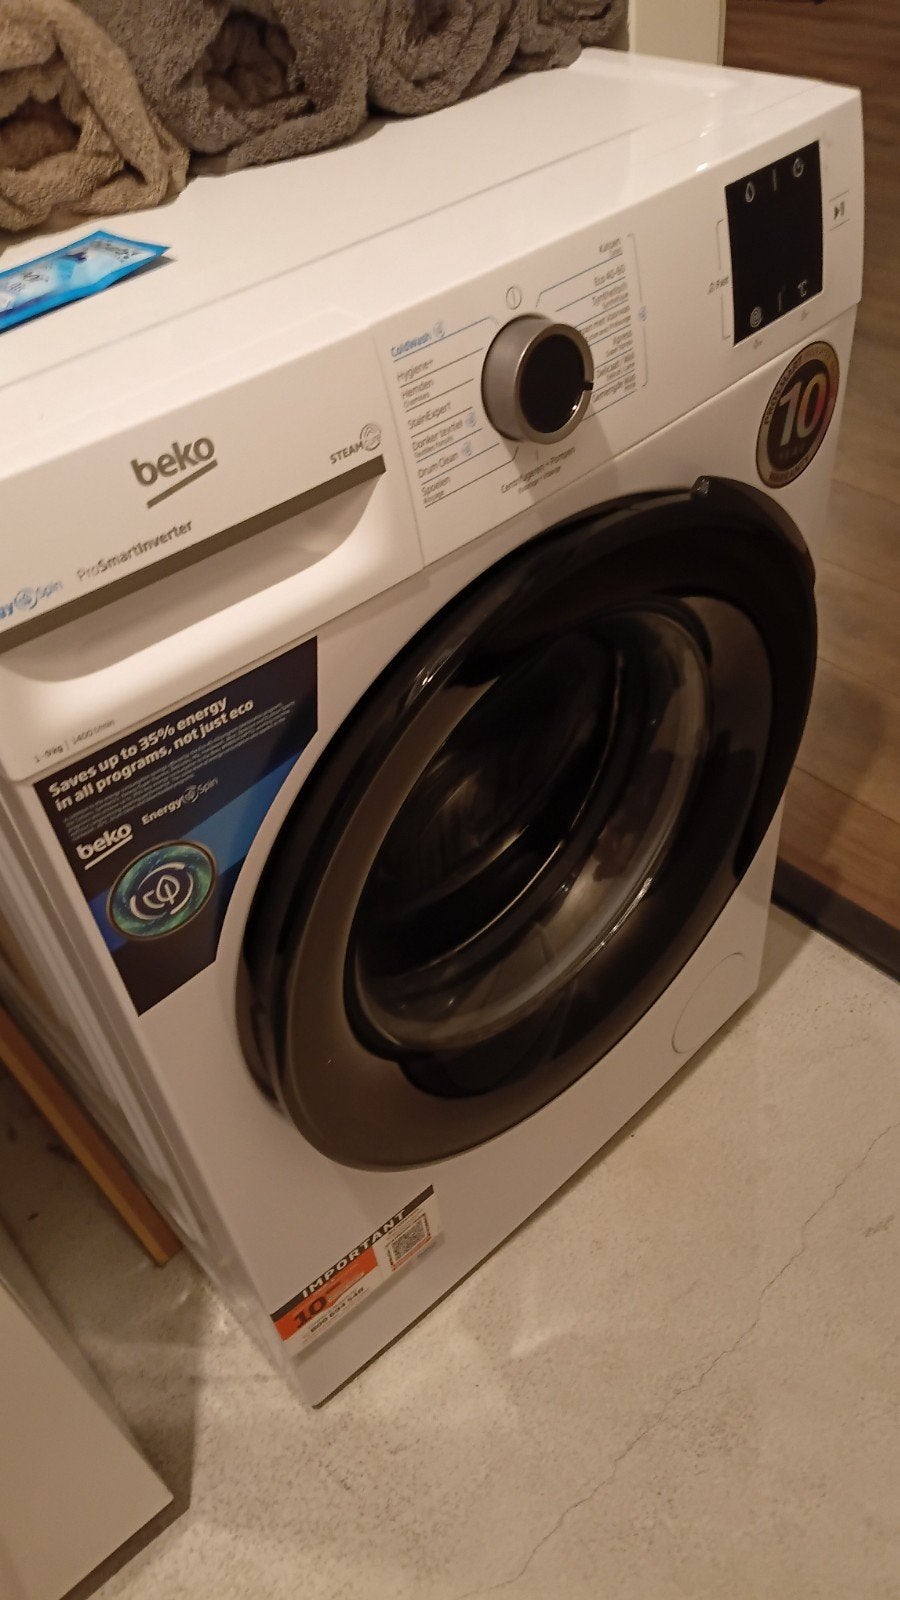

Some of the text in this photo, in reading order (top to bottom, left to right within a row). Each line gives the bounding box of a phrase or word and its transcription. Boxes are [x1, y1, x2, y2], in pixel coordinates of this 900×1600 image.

[778, 373, 828, 447] 10
[131, 437, 216, 487] beko
[330, 442, 365, 465] STEAM
[418, 463, 440, 479] Drum
[76, 520, 193, 582] ProSmartInverter
[48, 696, 228, 798] Saves up to 35% energy
[54, 699, 254, 812] in all programs, not just eco
[141, 776, 220, 826] Energy Spin
[76, 823, 132, 860] beko
[302, 1209, 406, 1298] IMPORTANT
[294, 1296, 327, 1329] 10
